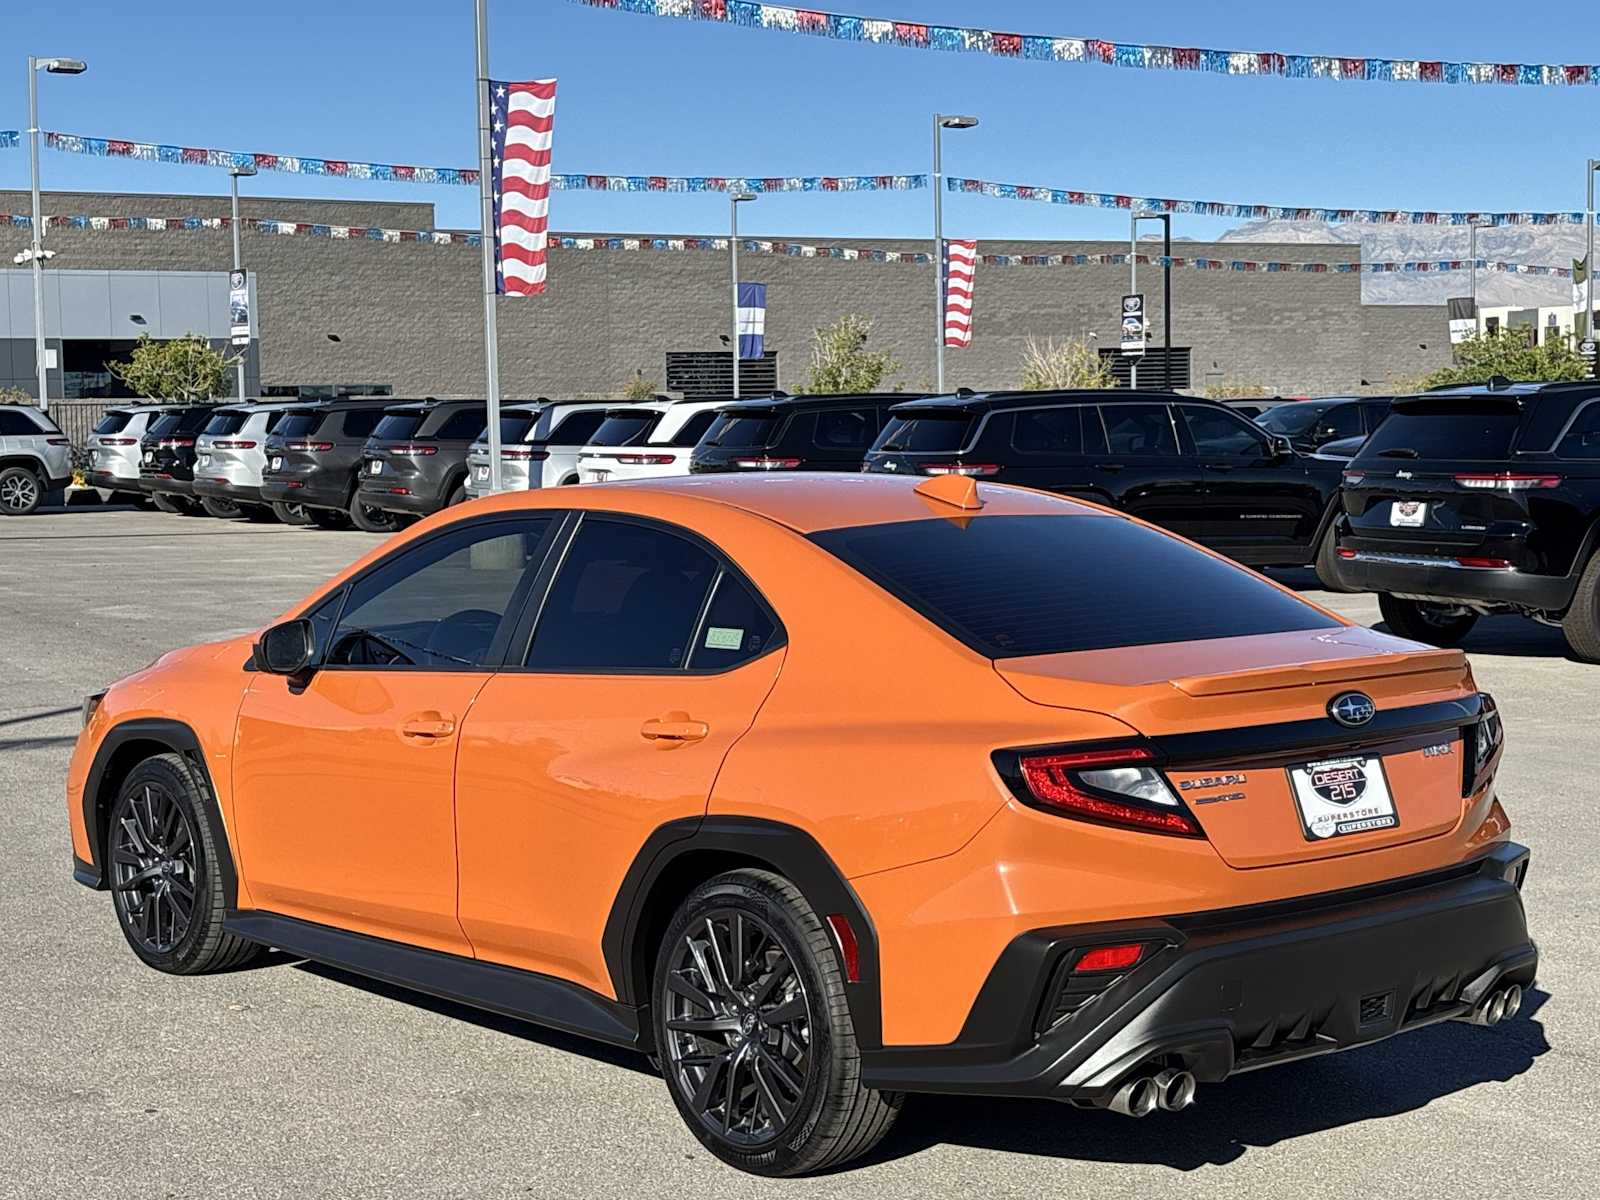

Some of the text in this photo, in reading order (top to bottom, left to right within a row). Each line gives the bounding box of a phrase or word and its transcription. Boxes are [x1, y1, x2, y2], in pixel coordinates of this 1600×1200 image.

[1180, 774, 1248, 791] SUBARU
[1314, 767, 1361, 786] DESERT
[1328, 782, 1357, 801] 215
[1317, 807, 1380, 823] SUPERSTORE
[1340, 818, 1393, 832] SUPERSTORE
